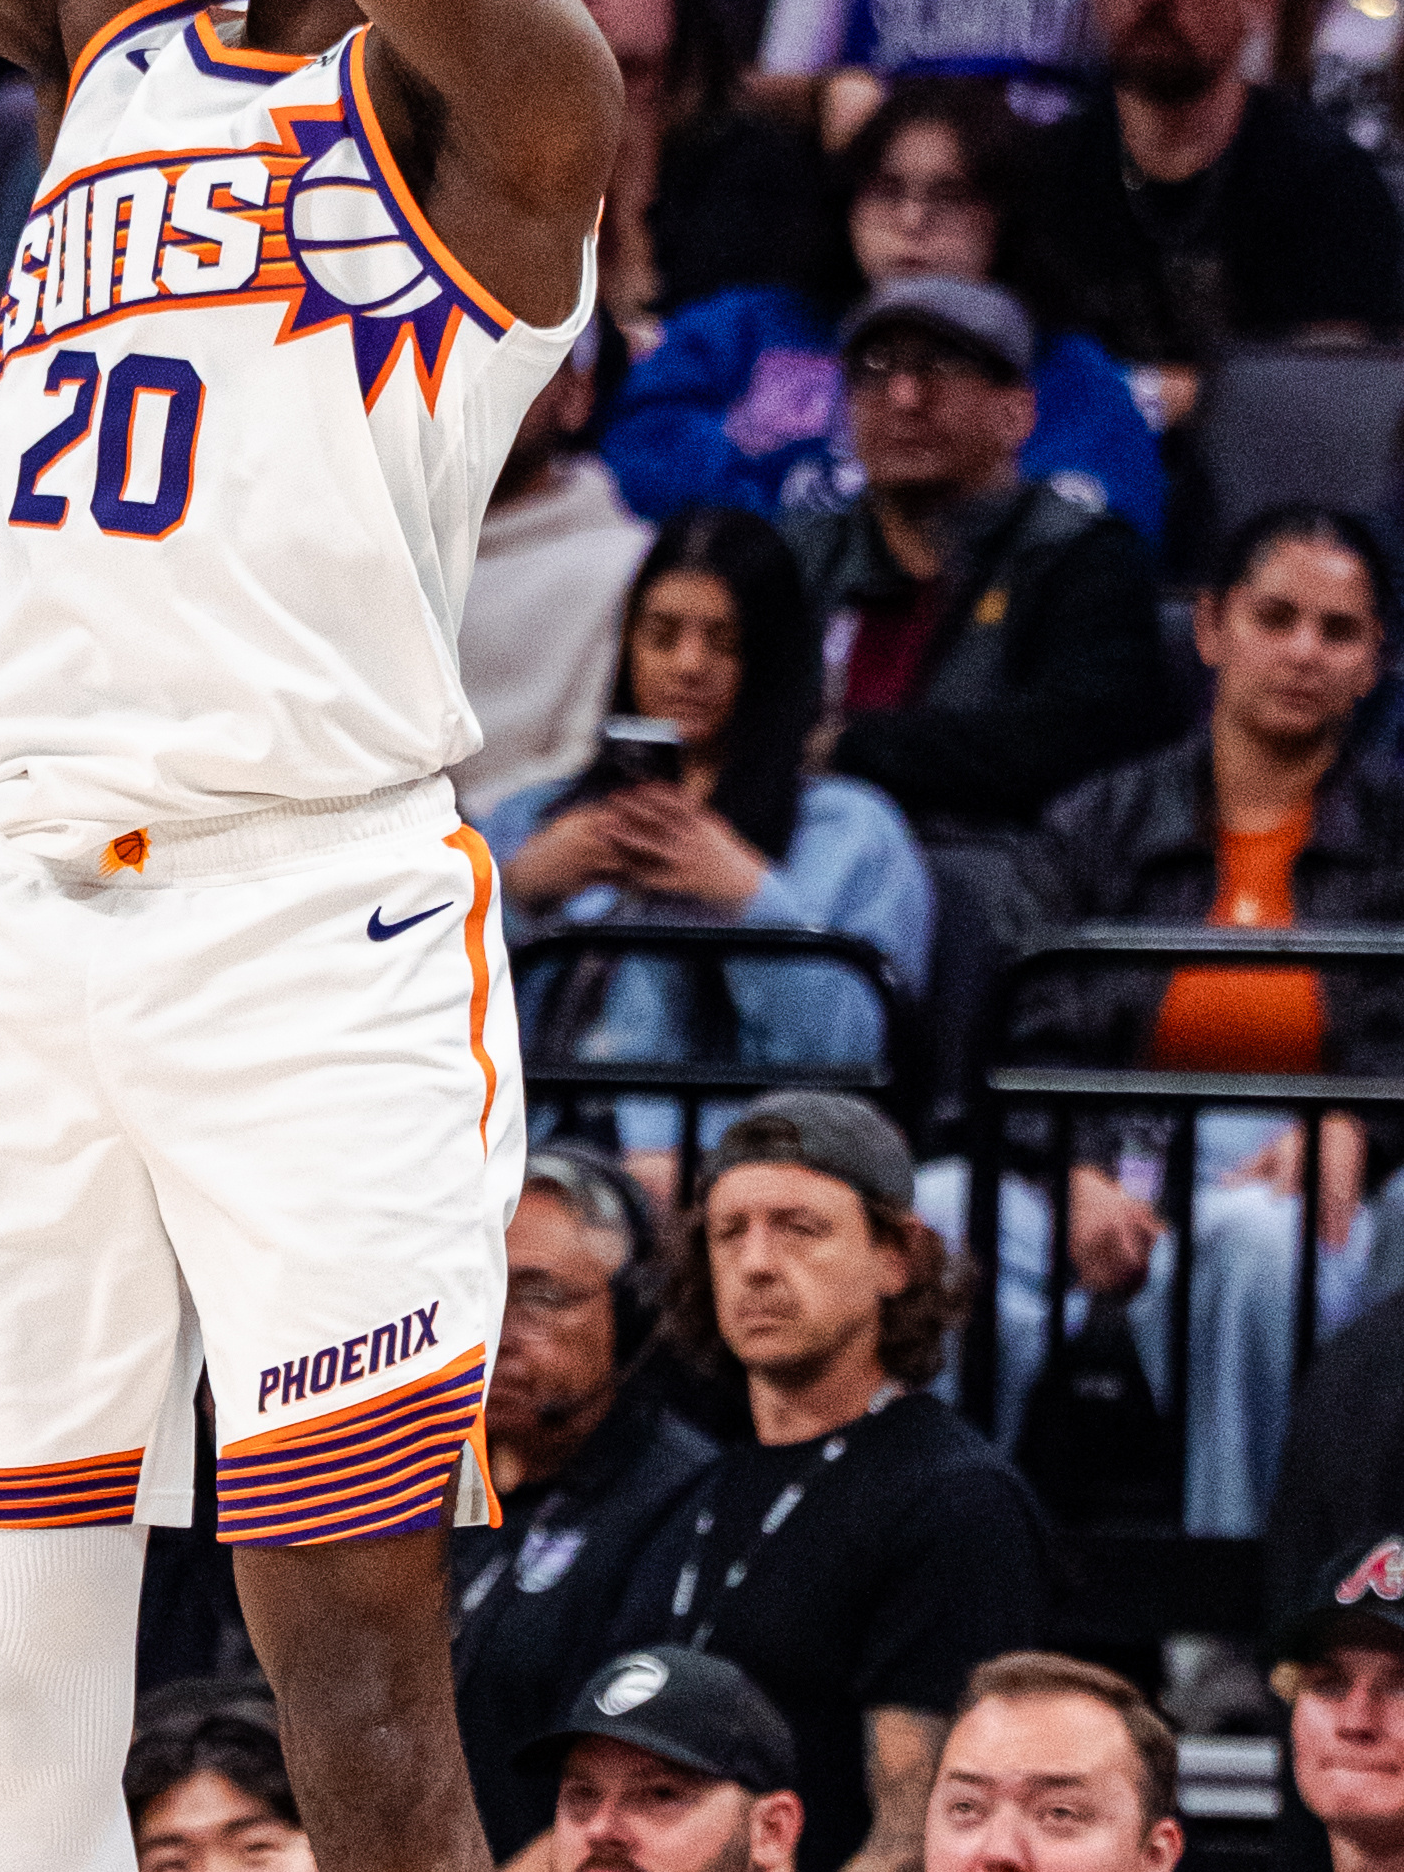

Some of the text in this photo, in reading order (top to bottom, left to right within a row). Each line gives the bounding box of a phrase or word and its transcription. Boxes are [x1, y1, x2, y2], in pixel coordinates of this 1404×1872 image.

[1, 153, 272, 357] SUNS
[7, 348, 207, 542] 20
[256, 1298, 441, 1415] PHOENIX
